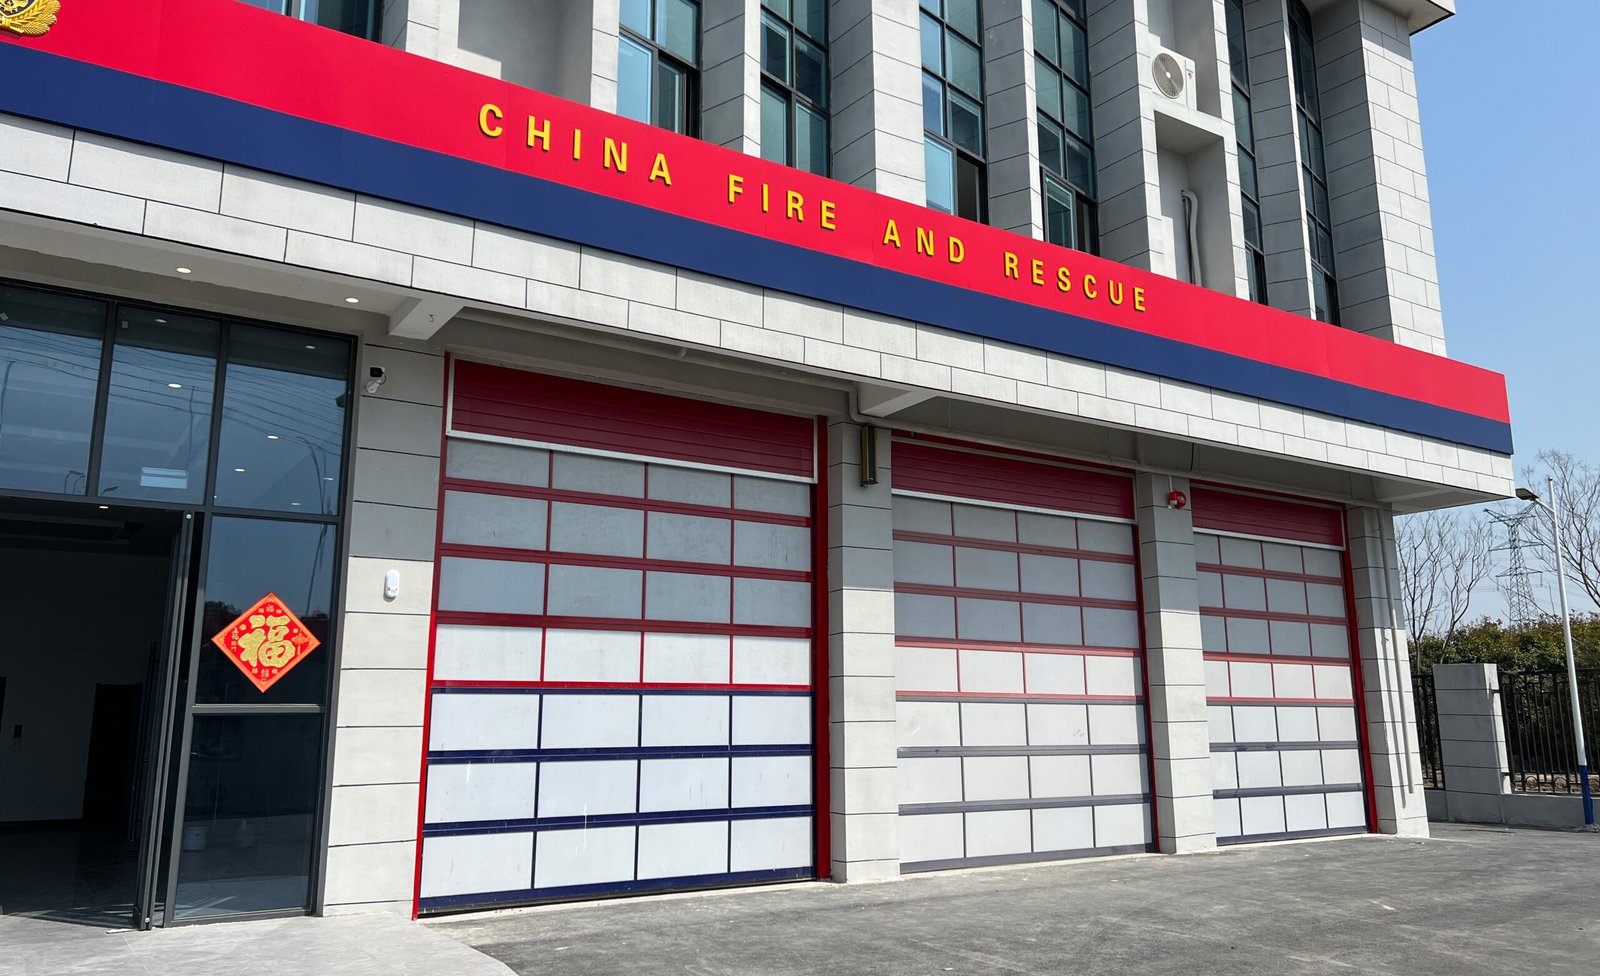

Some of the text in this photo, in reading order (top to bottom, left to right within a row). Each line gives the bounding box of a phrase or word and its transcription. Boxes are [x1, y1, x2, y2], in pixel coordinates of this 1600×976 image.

[479, 103, 1146, 312] CHINA FIRE AND RESCUE
[238, 615, 296, 668] 福
